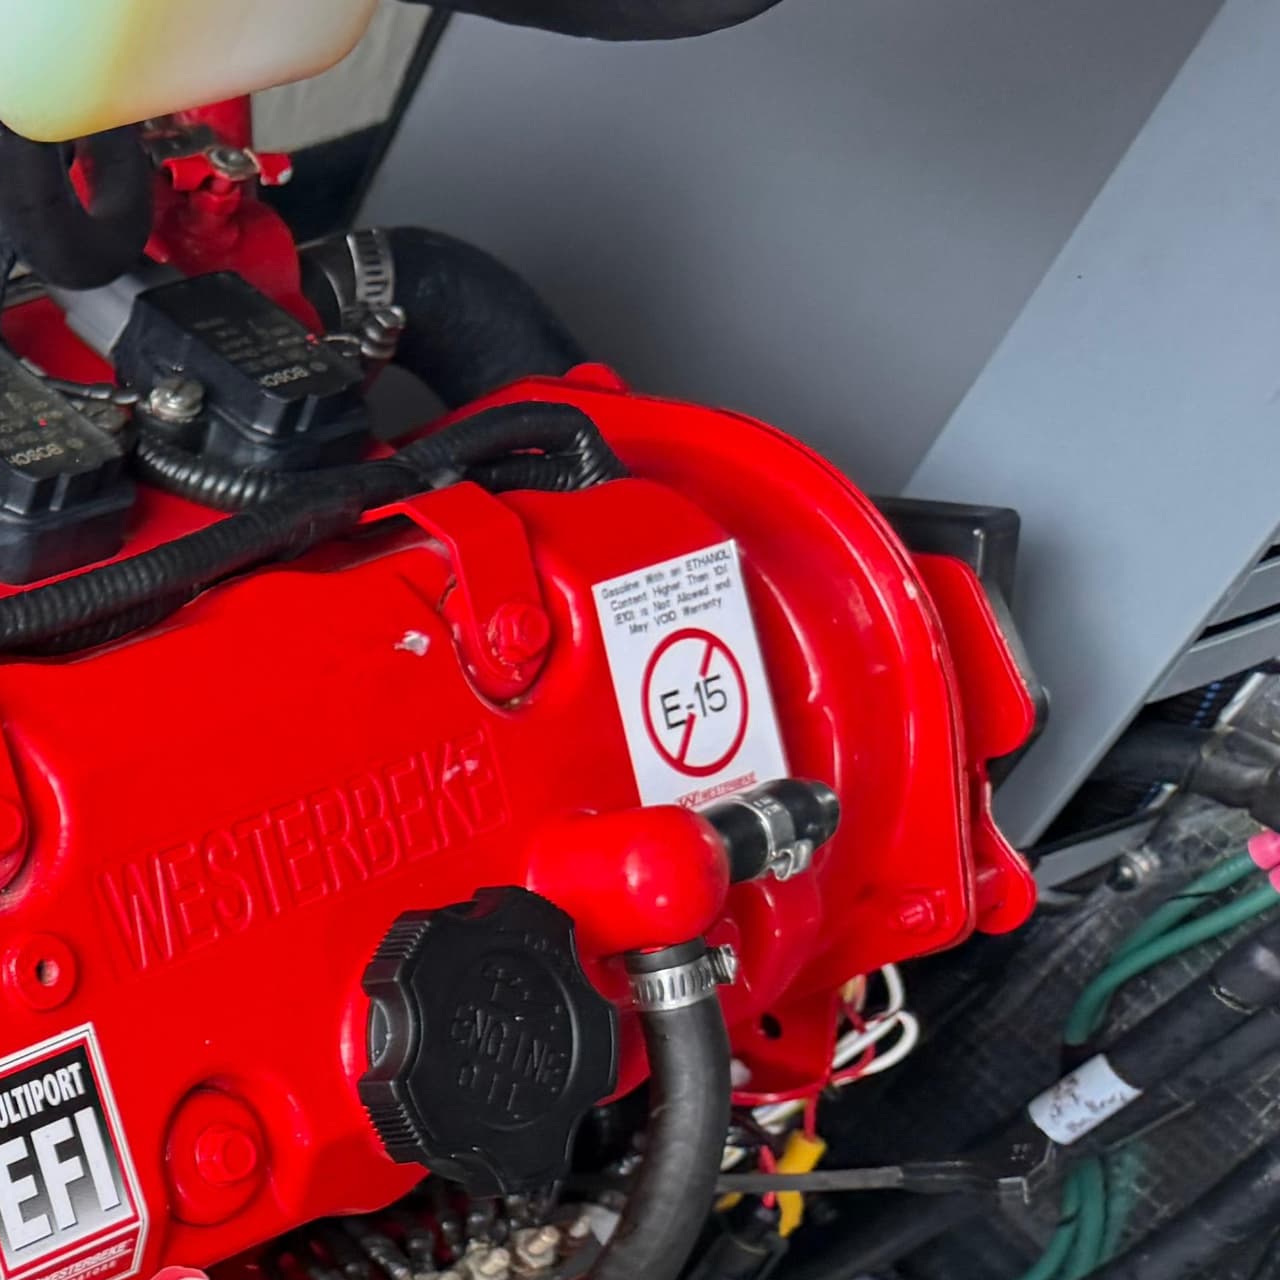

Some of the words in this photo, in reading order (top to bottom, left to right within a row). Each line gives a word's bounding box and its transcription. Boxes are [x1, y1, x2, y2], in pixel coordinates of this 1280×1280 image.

[686, 549, 731, 572] ETHANOL
[659, 674, 728, 731] E-15
[100, 726, 504, 976] WESTERBEKE
